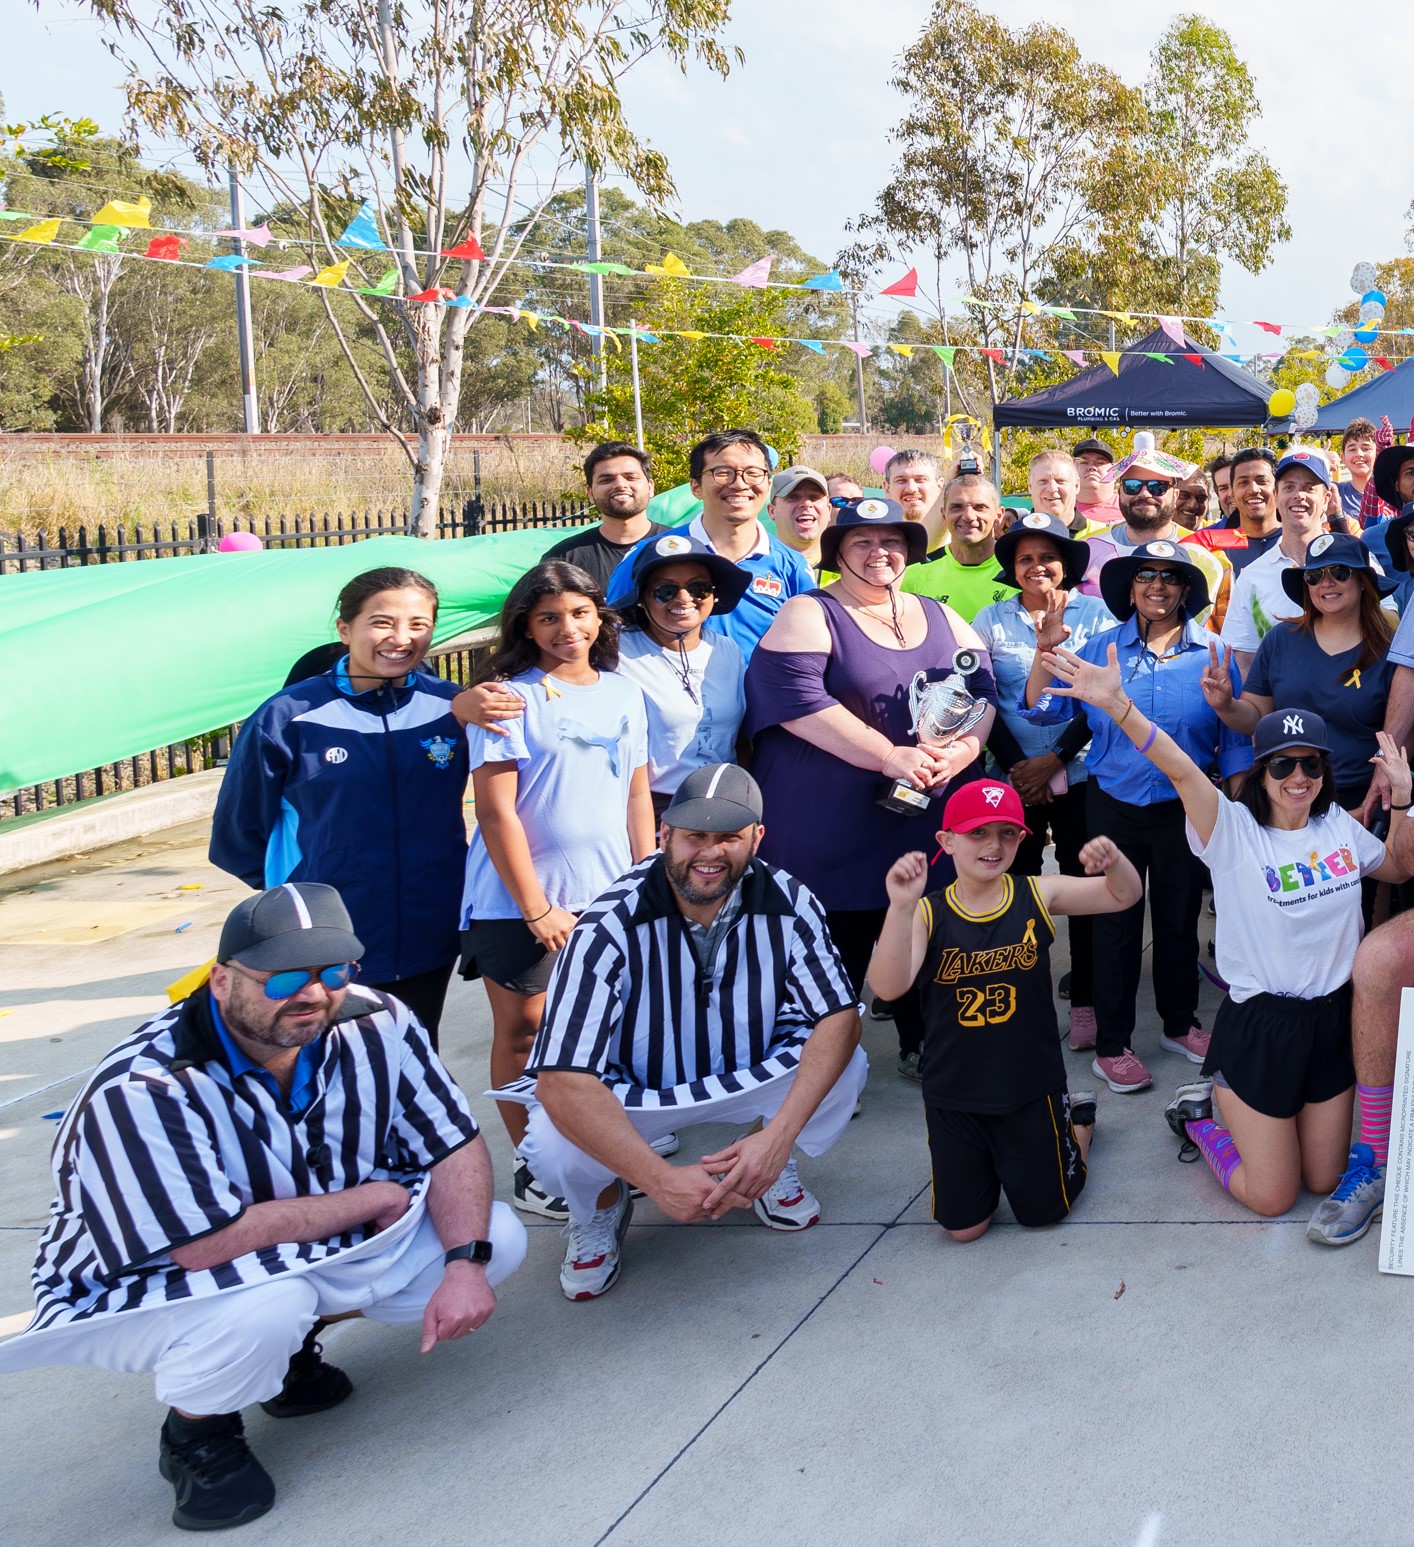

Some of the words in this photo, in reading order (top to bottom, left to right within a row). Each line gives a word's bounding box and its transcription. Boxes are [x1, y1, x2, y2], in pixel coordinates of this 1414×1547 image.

[1067, 405, 1119, 417] BROMIC
[1307, 893, 1318, 901] for
[1319, 888, 1335, 897] kids
[1335, 883, 1350, 892] with
[933, 941, 1038, 984] LAKERS
[956, 983, 1016, 1027] 23
[1403, 1050, 1411, 1084] SIGNATURE
[1400, 1086, 1408, 1132] MICROPRINTED
[1397, 1133, 1405, 1164] CONTAINS
[1400, 1204, 1408, 1234] ABSENCE
[1388, 1239, 1396, 1270] SECURITY
